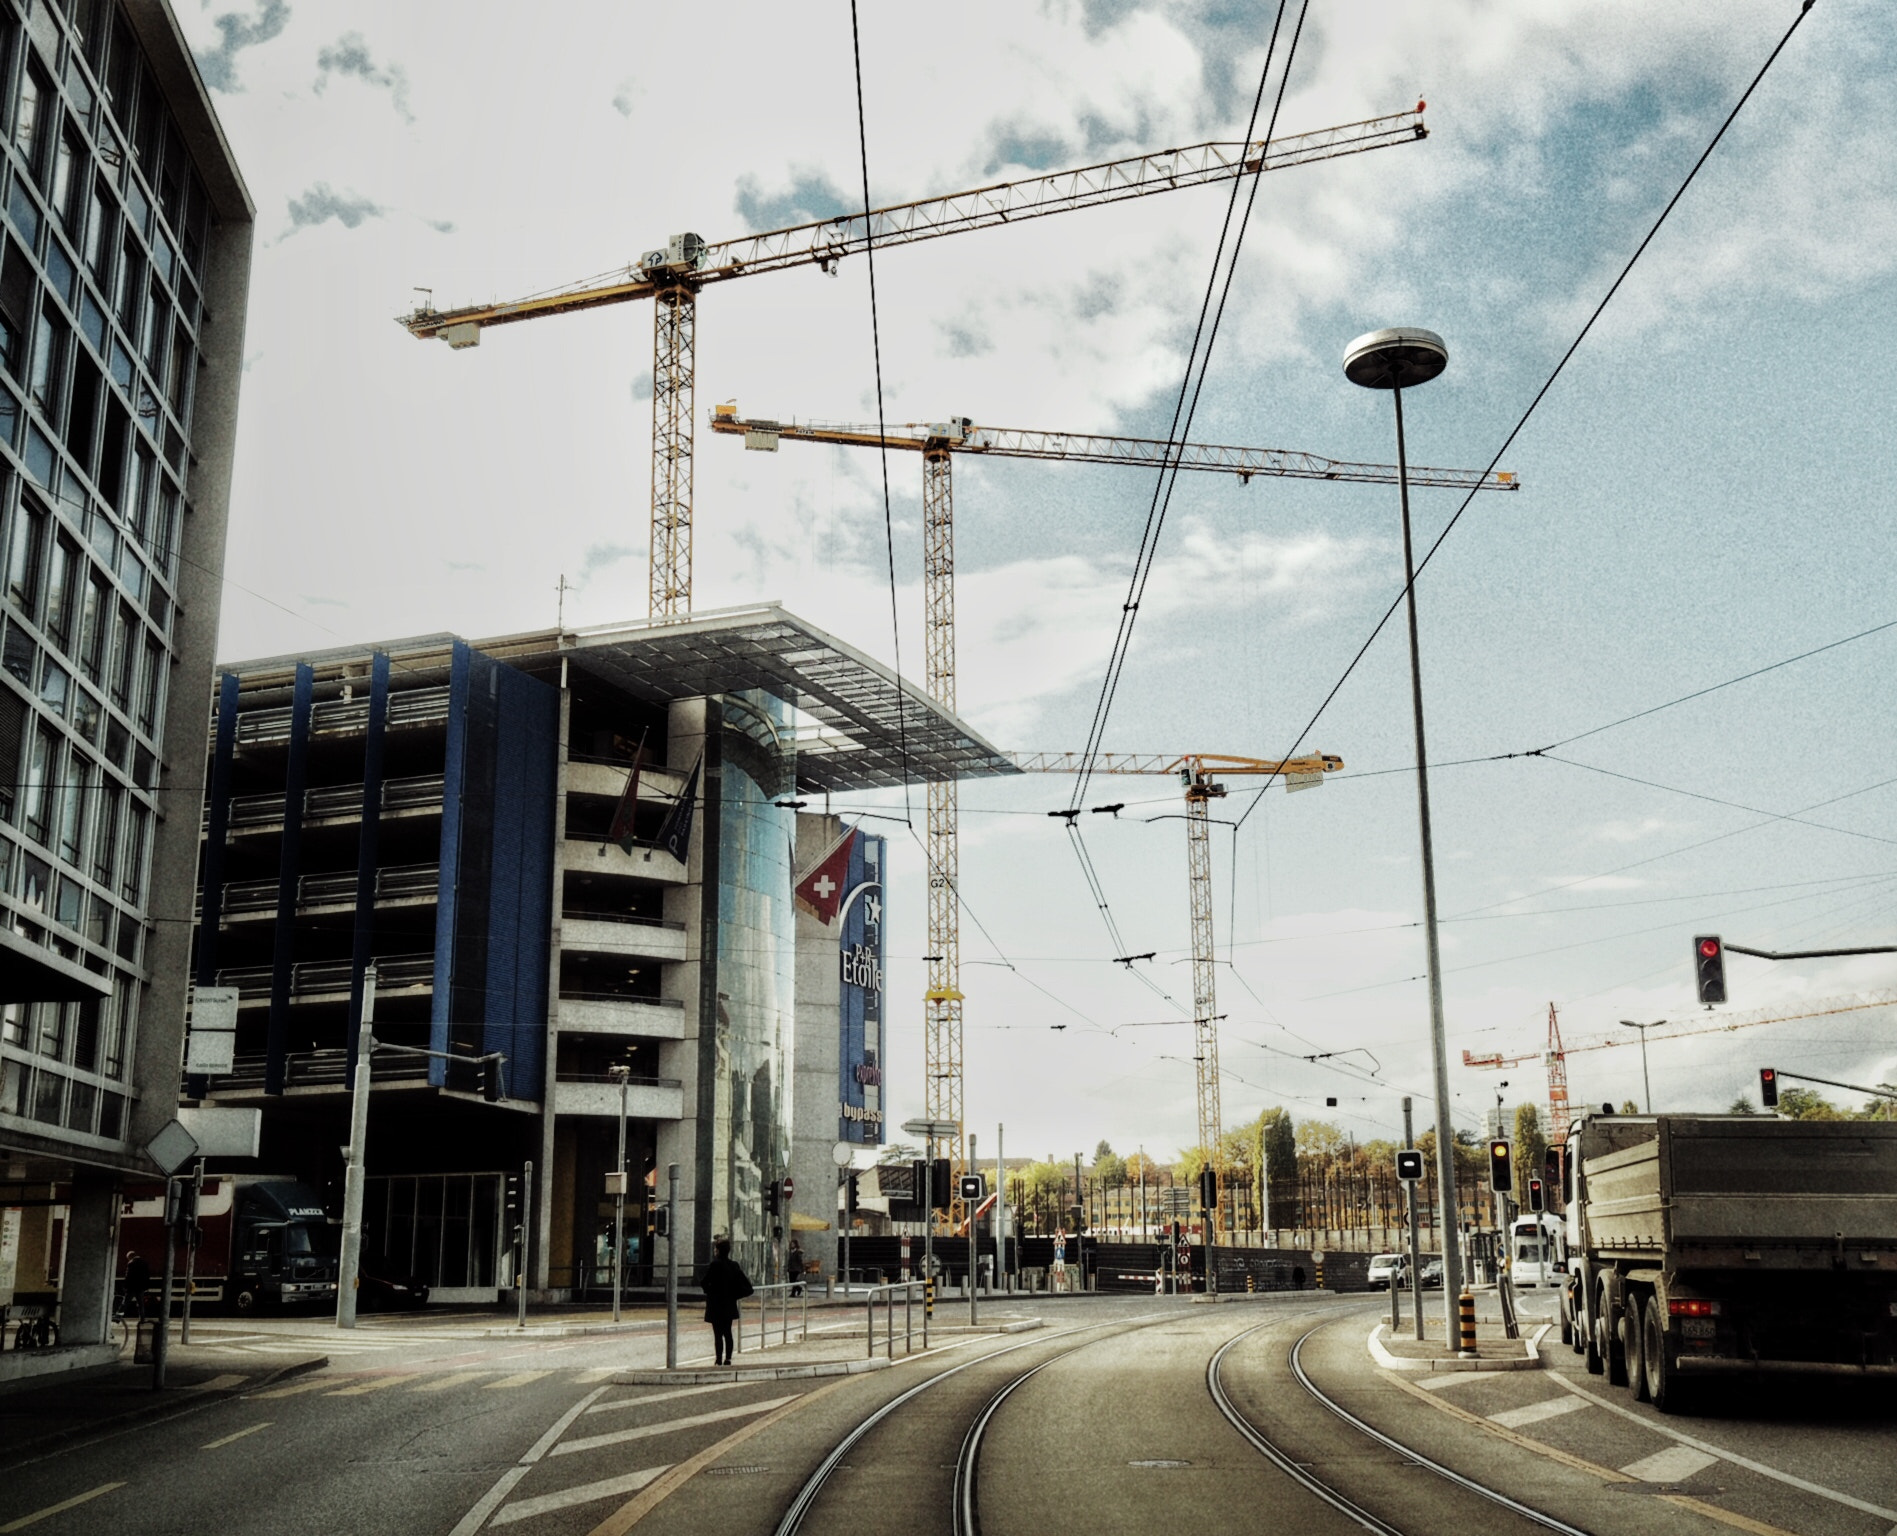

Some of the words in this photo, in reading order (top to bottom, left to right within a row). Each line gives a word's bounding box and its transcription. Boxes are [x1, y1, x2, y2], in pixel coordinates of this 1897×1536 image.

[931, 878, 945, 889] G2
[855, 943, 872, 966] P+R
[842, 949, 883, 992] Etoile
[844, 1099, 882, 1122] bypass
